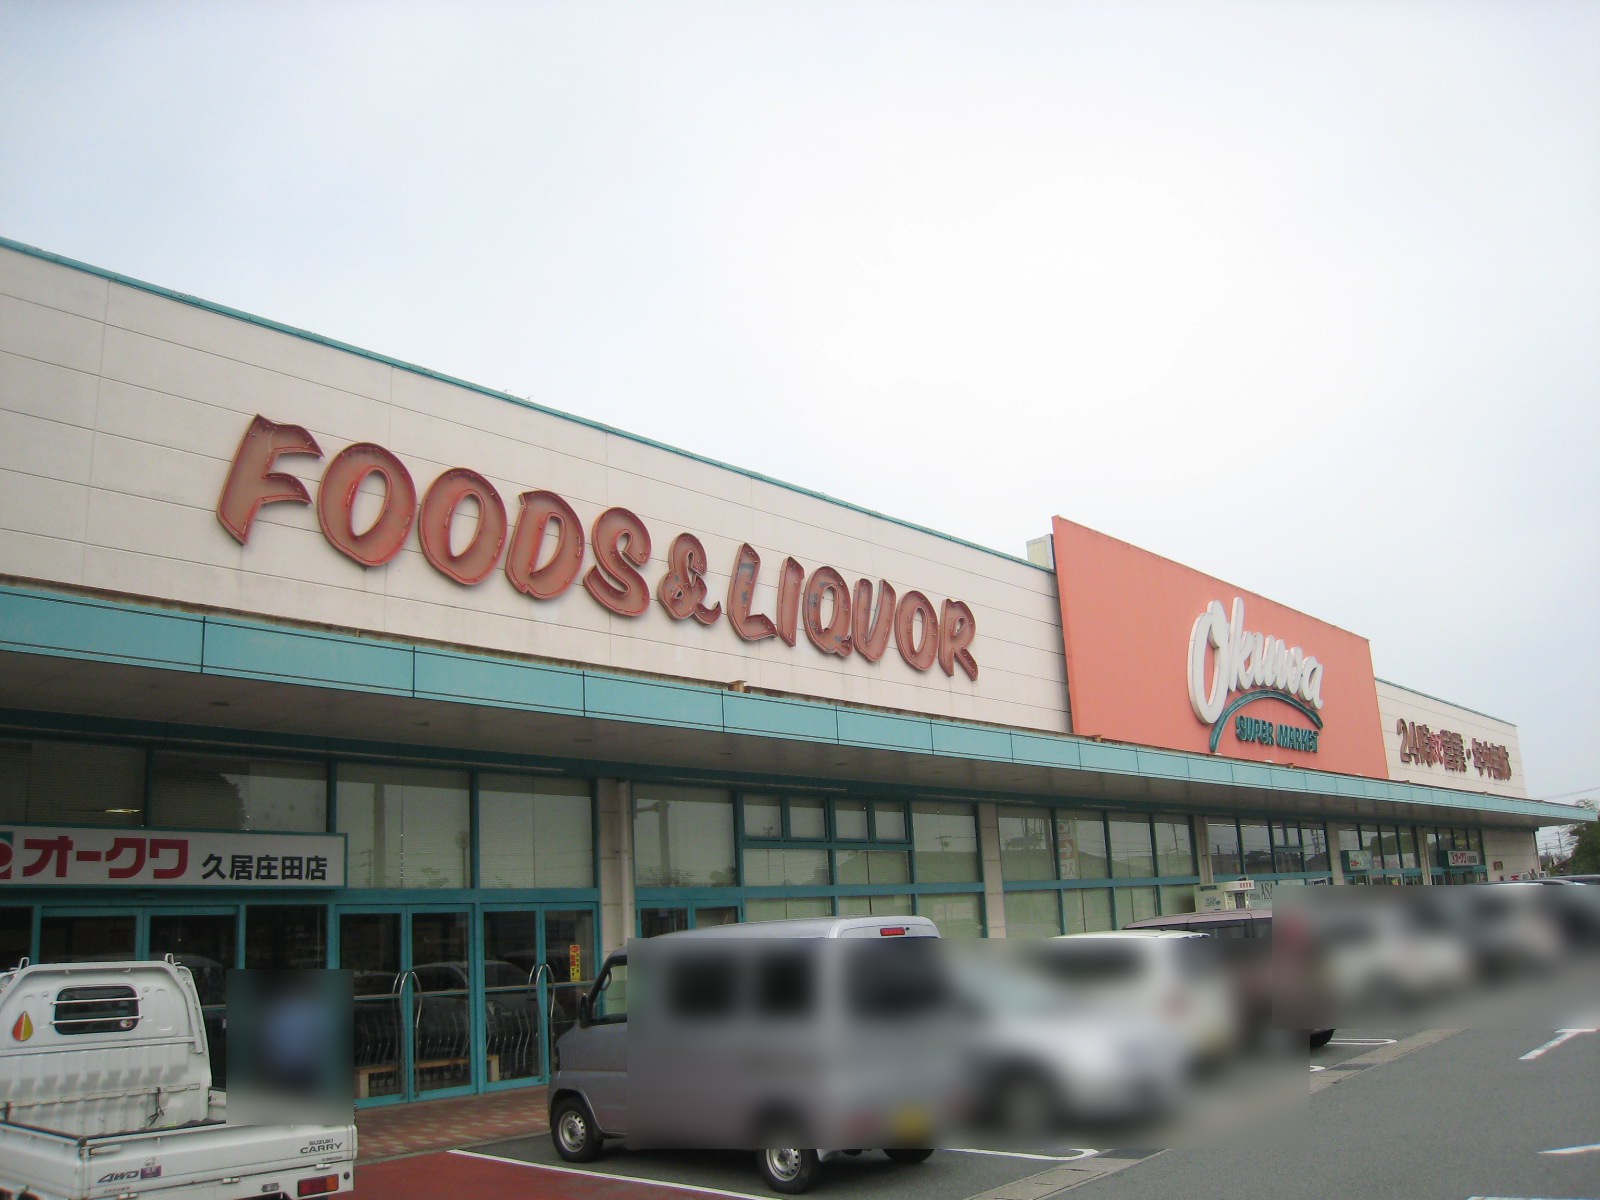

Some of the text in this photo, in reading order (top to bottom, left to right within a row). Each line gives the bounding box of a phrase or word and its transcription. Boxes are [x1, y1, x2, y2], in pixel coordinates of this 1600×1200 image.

[1187, 596, 1324, 724] Okuwa
[1235, 715, 1319, 754] SUPER MARKET
[22, 835, 328, 881] オークワ 久居庄田店
[300, 1142, 343, 1154] CARRY
[309, 1138, 334, 1146] SUZUKI
[97, 1170, 140, 1184] 4WD
